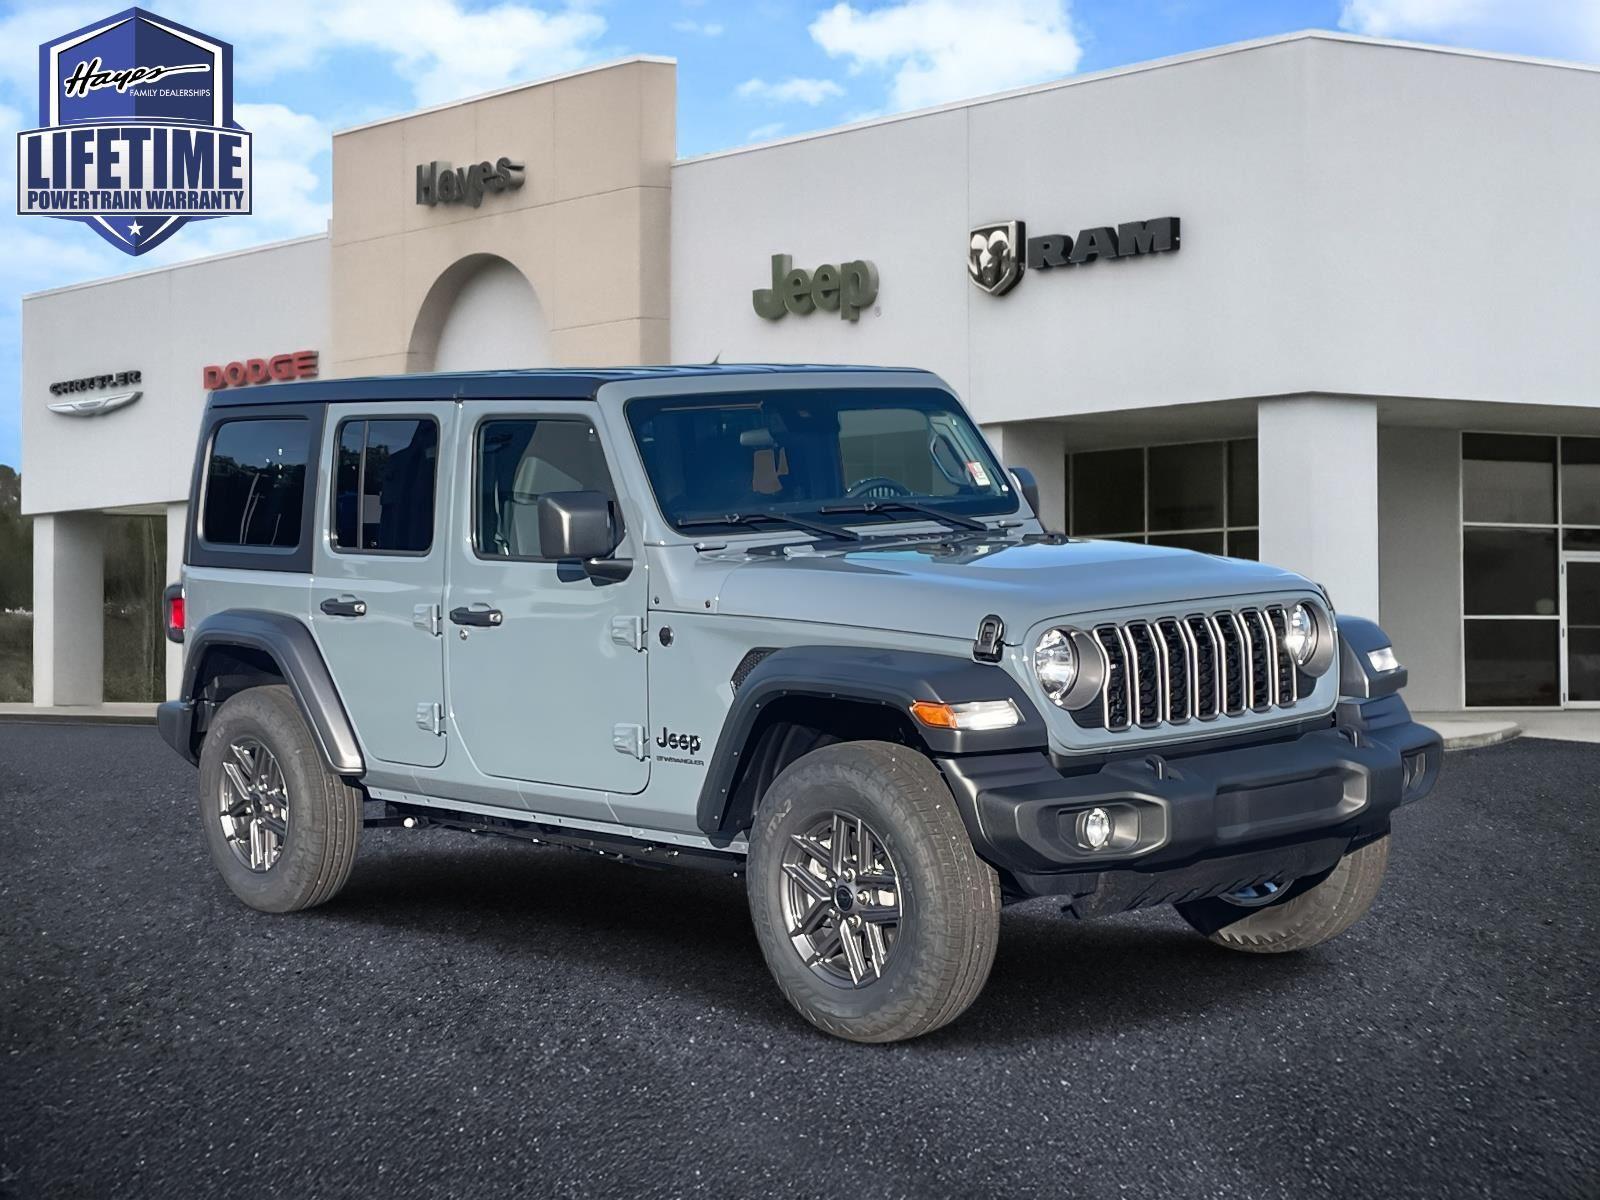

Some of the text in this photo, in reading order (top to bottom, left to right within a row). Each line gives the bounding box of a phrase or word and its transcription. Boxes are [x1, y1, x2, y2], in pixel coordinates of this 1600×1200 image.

[416, 156, 525, 208] Hayes
[1027, 216, 1180, 270] RAM
[752, 253, 880, 323] Jeep
[203, 350, 319, 390] DODGE
[656, 726, 702, 755] Jeep
